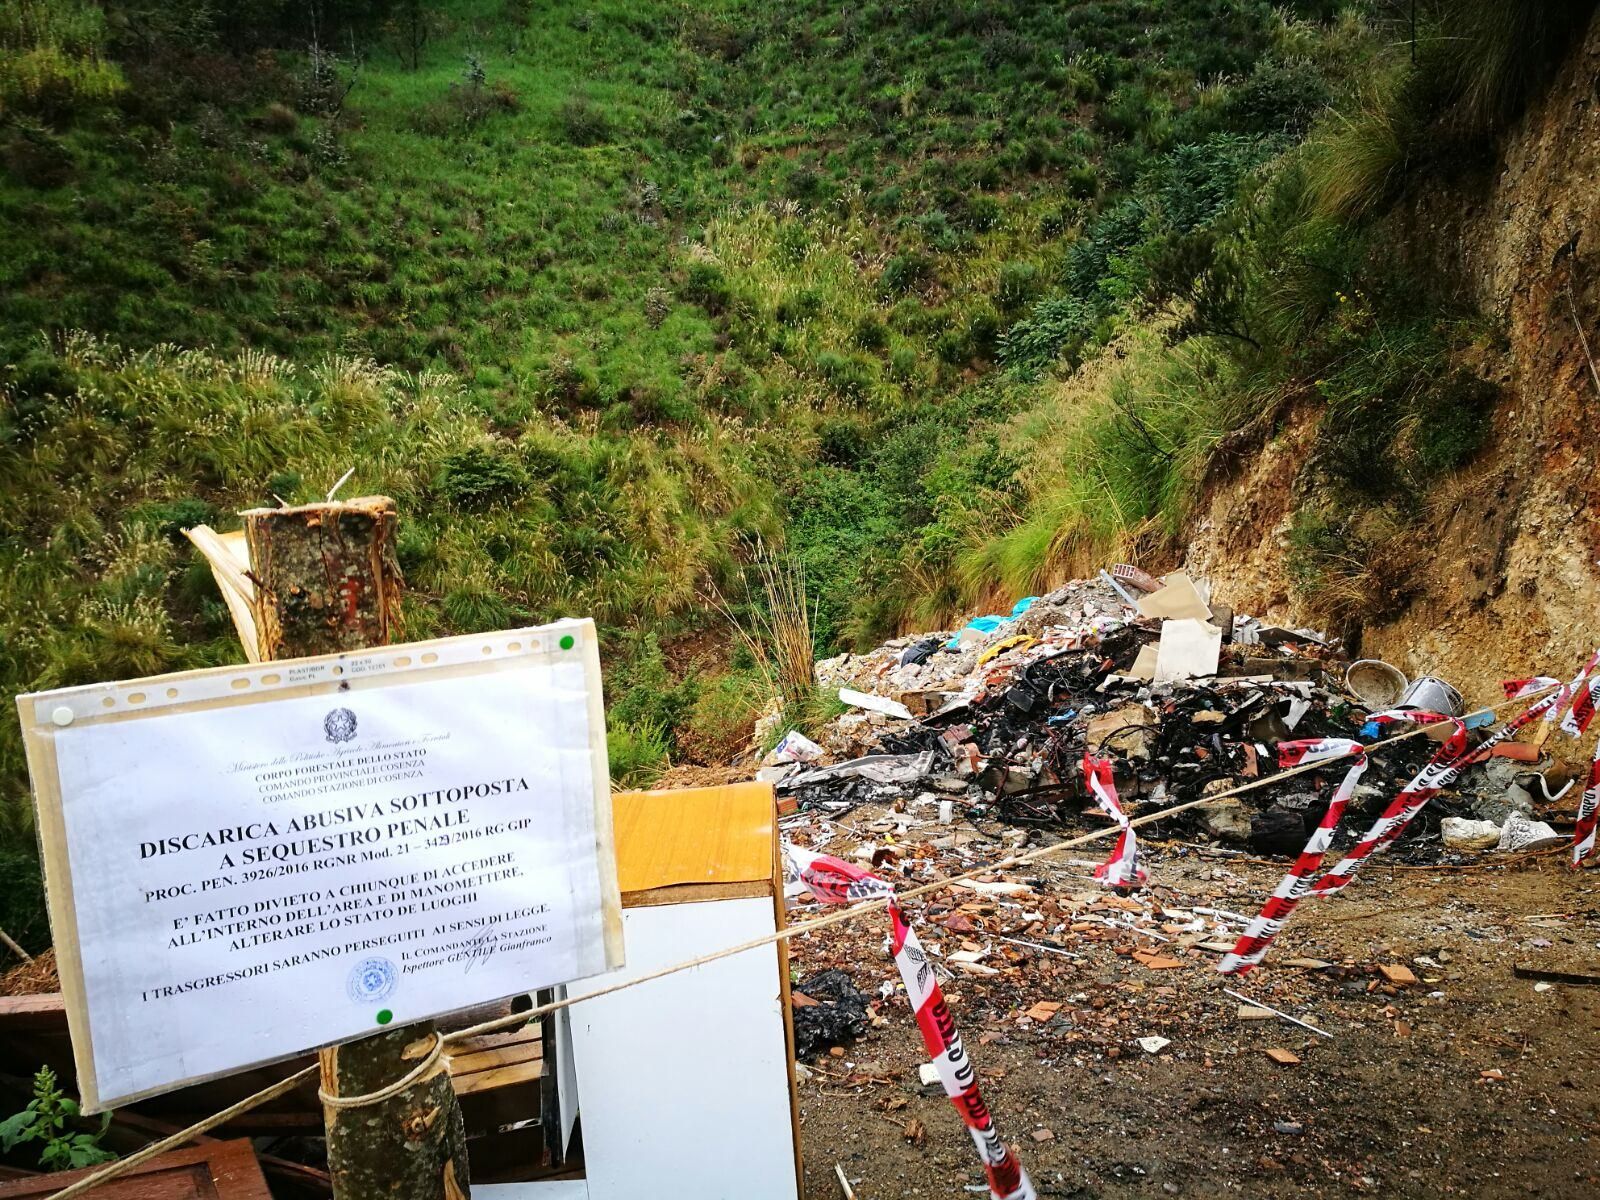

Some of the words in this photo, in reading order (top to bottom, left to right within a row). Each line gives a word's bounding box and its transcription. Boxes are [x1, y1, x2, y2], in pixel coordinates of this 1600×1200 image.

[255, 768, 292, 783] CORPO
[295, 759, 355, 776] FORESTALE
[357, 752, 391, 766] DELLO
[393, 748, 427, 760] STATO
[258, 776, 312, 794] COMANDO
[313, 765, 379, 784] PROVINCIALE
[380, 759, 425, 772] COSENZA
[262, 787, 316, 804] COMANDO
[317, 778, 367, 795] STAZIONE
[367, 776, 377, 786] DI
[378, 769, 424, 783] COSENZA
[139, 821, 279, 859] DISCARICA
[286, 802, 384, 834] ABUSIVA
[390, 777, 530, 814] SOTTOPOSTA
[219, 853, 236, 870] A
[242, 826, 381, 866] SEQUESTRO
[387, 808, 470, 839] PENALE
[145, 883, 197, 903] PROC.
[201, 875, 238, 892] PEN.
[241, 862, 309, 884] 3926/2016
[313, 853, 357, 871] RGNR
[361, 848, 394, 863] Mod.
[397, 843, 410, 856] 21
[485, 823, 504, 836] RG
[508, 818, 532, 831] GIP
[194, 905, 249, 926] FATTO
[254, 891, 321, 913] DIVIETO
[325, 889, 336, 900] A
[339, 872, 419, 897] CHIUNQUE
[423, 869, 438, 881] DI
[442, 851, 516, 878] ACCEDERE
[229, 922, 316, 952] ALTERARE
[319, 918, 341, 931] LO
[344, 908, 394, 927] STATO
[398, 904, 417, 916] DE
[421, 892, 478, 912] LUOGHI
[378, 893, 387, 905] E
[391, 891, 406, 903] DI
[142, 991, 148, 1002] I
[152, 963, 269, 999] TRASGRESSORI
[272, 945, 341, 971] SARANNO
[344, 928, 426, 955] PERSEGUITI
[432, 924, 446, 936] AI
[449, 917, 486, 933] SENSI
[489, 913, 502, 925] DI
[506, 903, 551, 921] LEGGE.
[402, 958, 445, 974] Ispettore
[447, 946, 497, 964] GENTILE
[499, 936, 553, 953] Gianfranco
[931, 1000, 964, 1063] STATO
